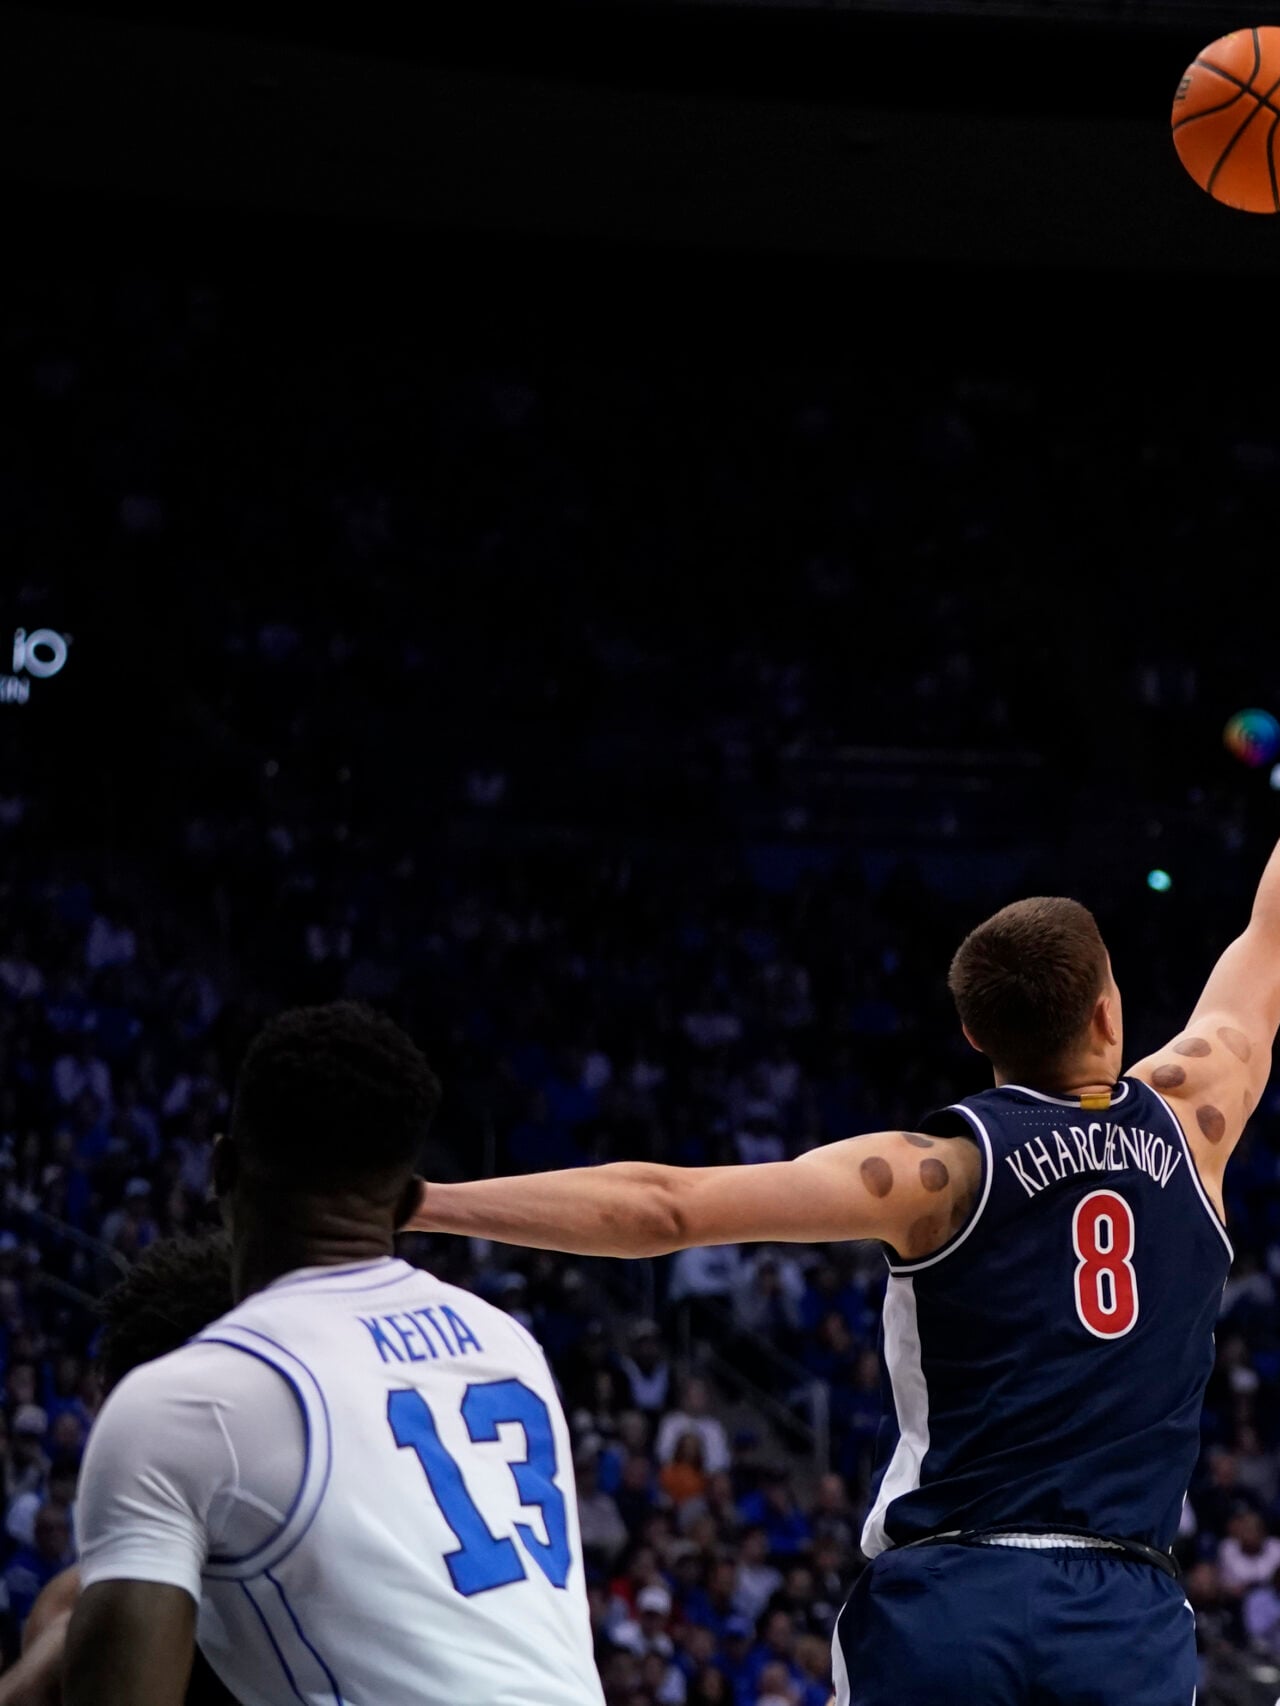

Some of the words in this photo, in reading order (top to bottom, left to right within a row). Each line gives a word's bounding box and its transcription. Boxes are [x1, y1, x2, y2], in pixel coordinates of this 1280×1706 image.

[1005, 1122, 1183, 1198] KHARCHENKOV
[1072, 1189, 1139, 1340] 8
[356, 1304, 484, 1363] KEITA
[387, 1378, 572, 1598] 13
